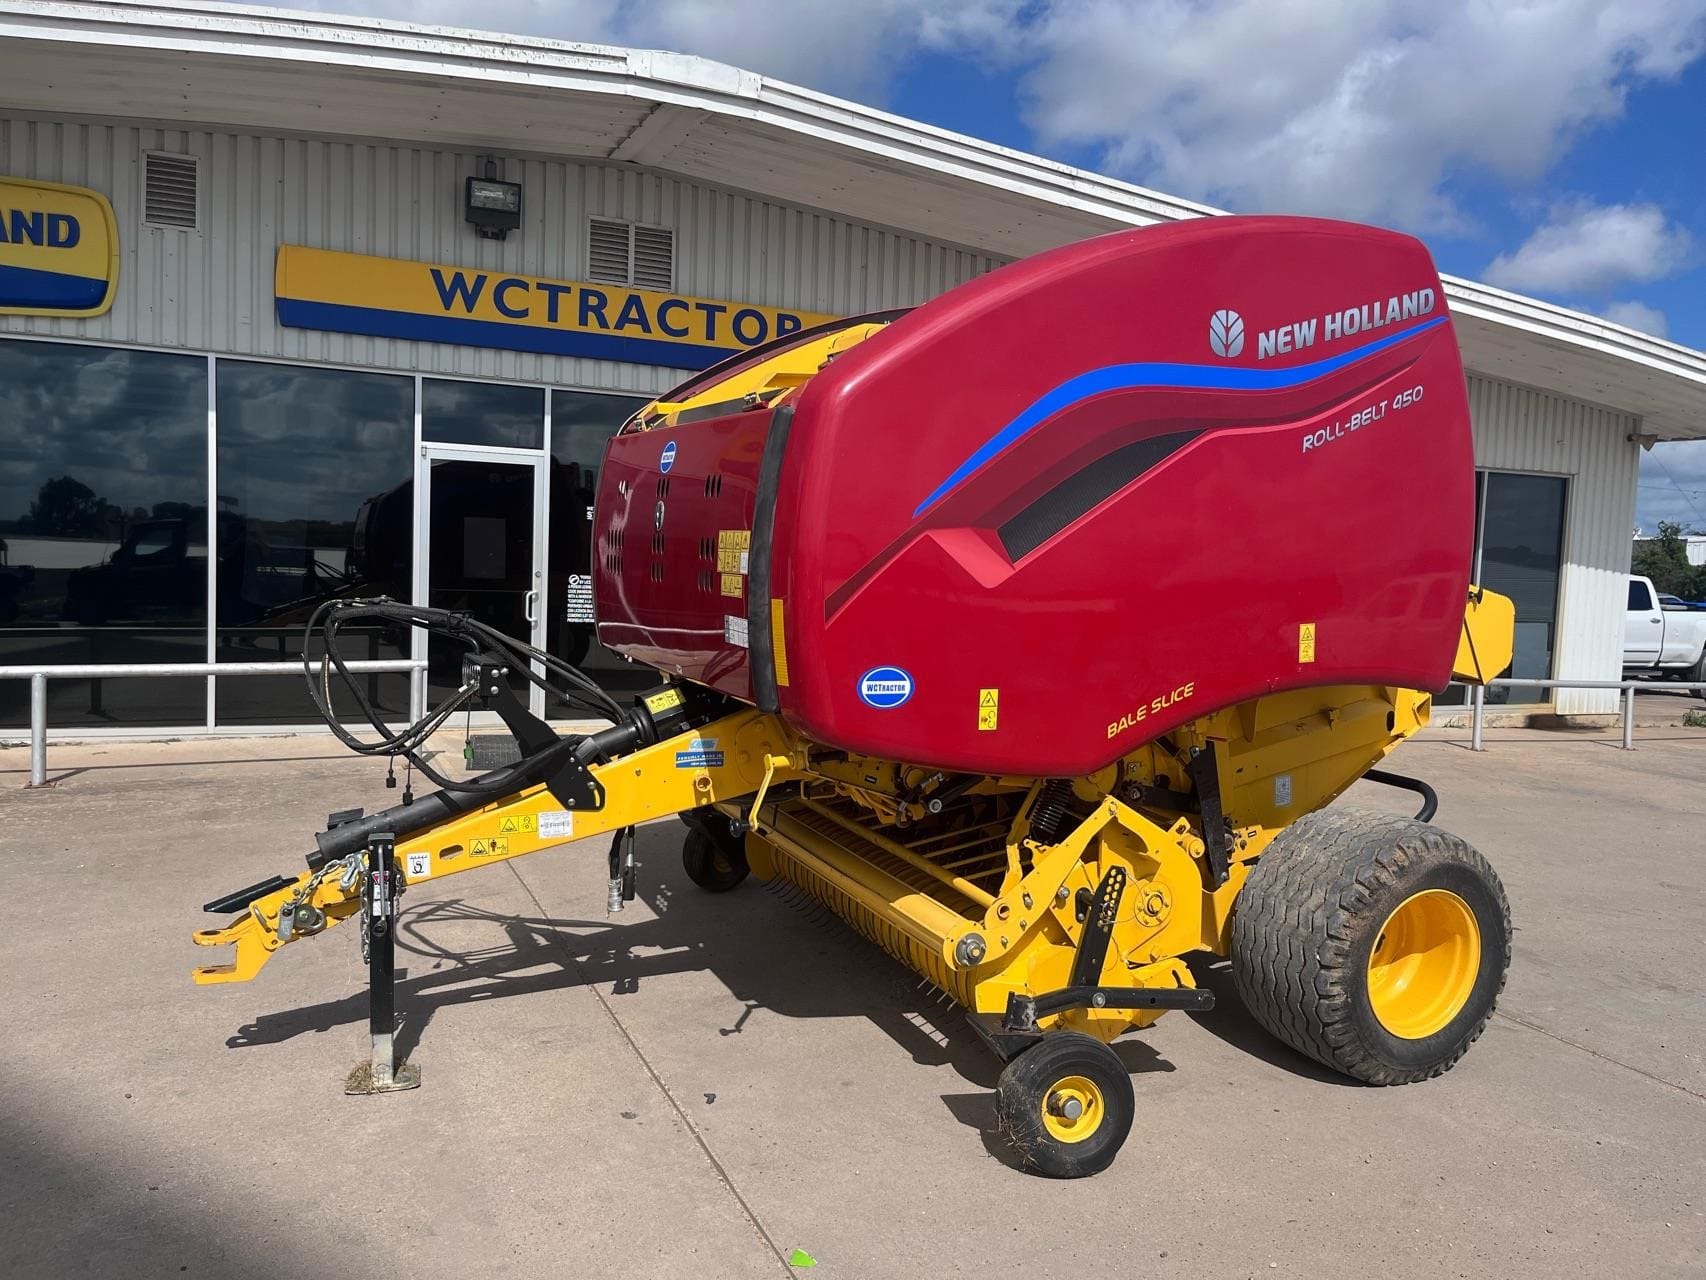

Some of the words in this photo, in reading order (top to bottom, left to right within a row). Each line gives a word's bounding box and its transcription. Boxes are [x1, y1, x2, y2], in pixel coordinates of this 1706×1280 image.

[0, 208, 80, 248] ND
[1257, 318, 1317, 360] NEW
[1324, 288, 1435, 341] HOLLAND
[1302, 400, 1388, 453] ROLL-BELT
[1393, 386, 1424, 410] 450
[1107, 705, 1147, 739] BALE
[1151, 682, 1195, 714] SLICE
